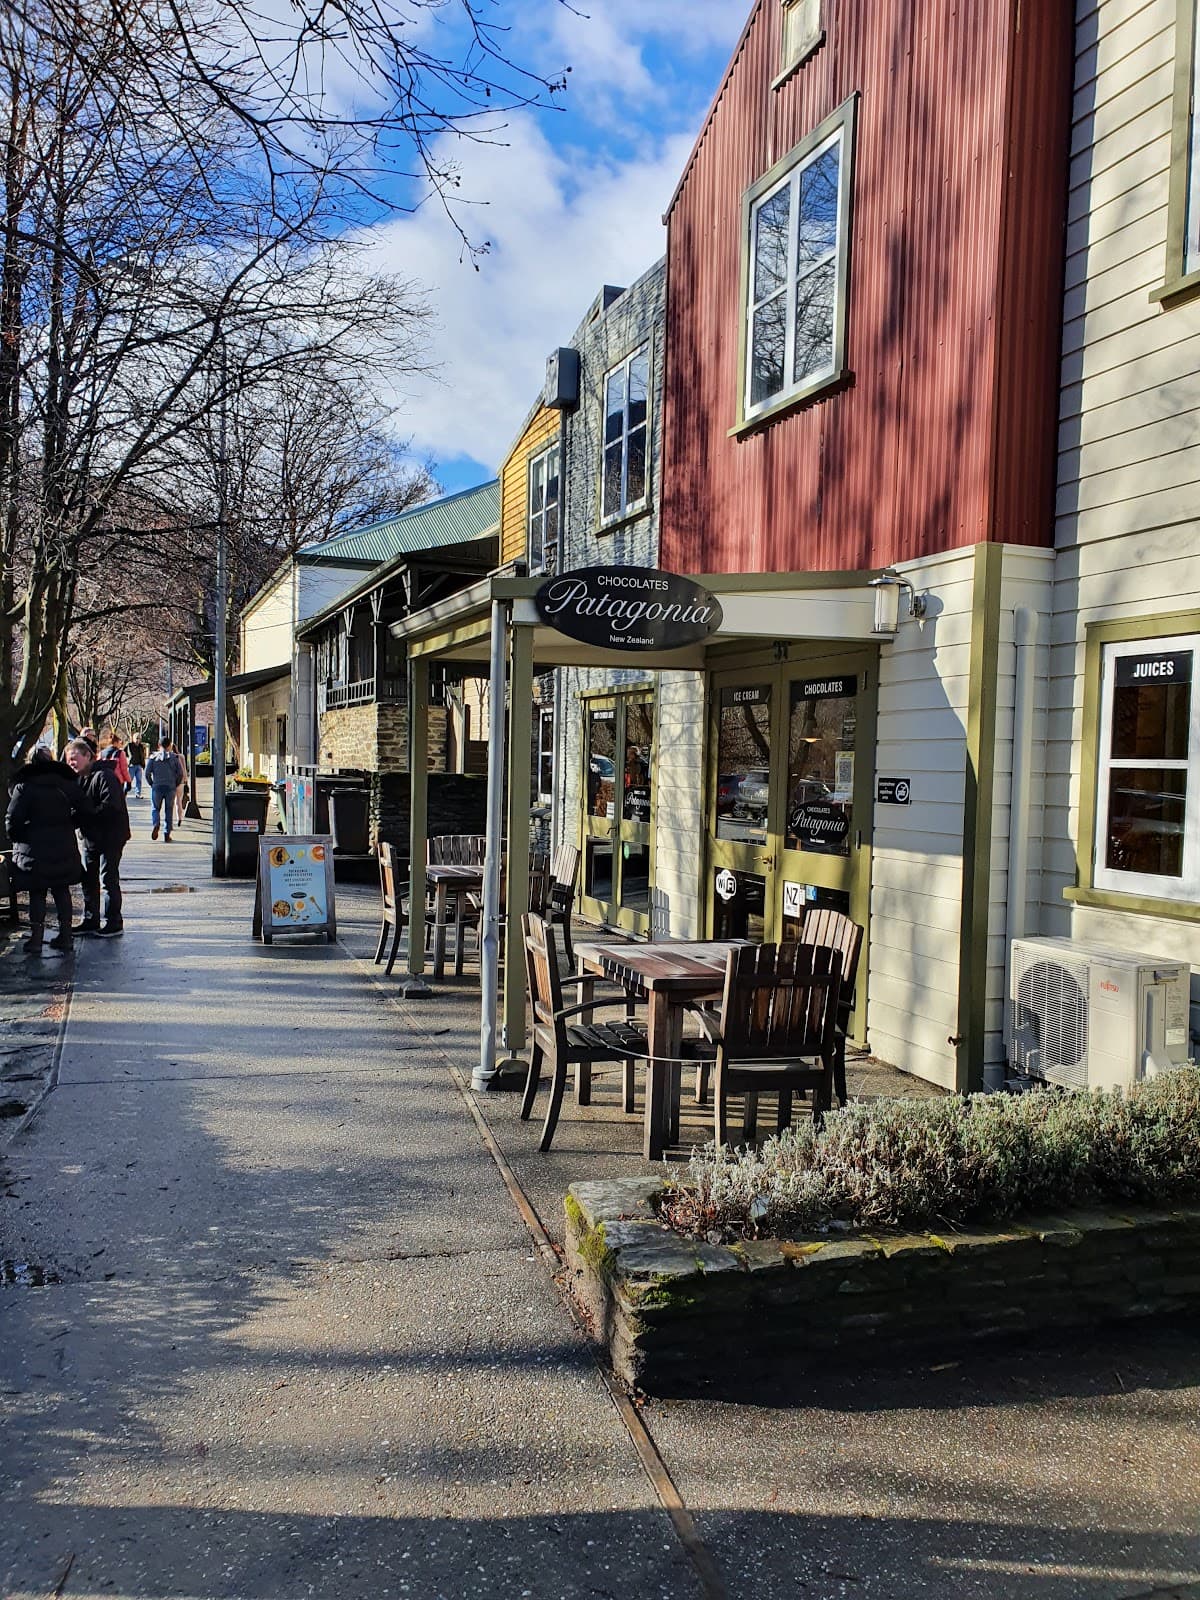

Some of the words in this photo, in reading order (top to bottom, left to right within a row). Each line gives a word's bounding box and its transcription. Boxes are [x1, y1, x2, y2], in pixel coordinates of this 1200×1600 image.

[597, 575, 669, 591] CHOCOLATES
[544, 578, 716, 631] Patagonia
[609, 634, 626, 644] New
[626, 635, 654, 645] Zealand
[1133, 660, 1174, 677] JUICES
[733, 691, 742, 702] ICE
[742, 689, 760, 701] CREAM
[804, 680, 843, 696] CHOCOLATES
[791, 808, 846, 836] Patagonia
